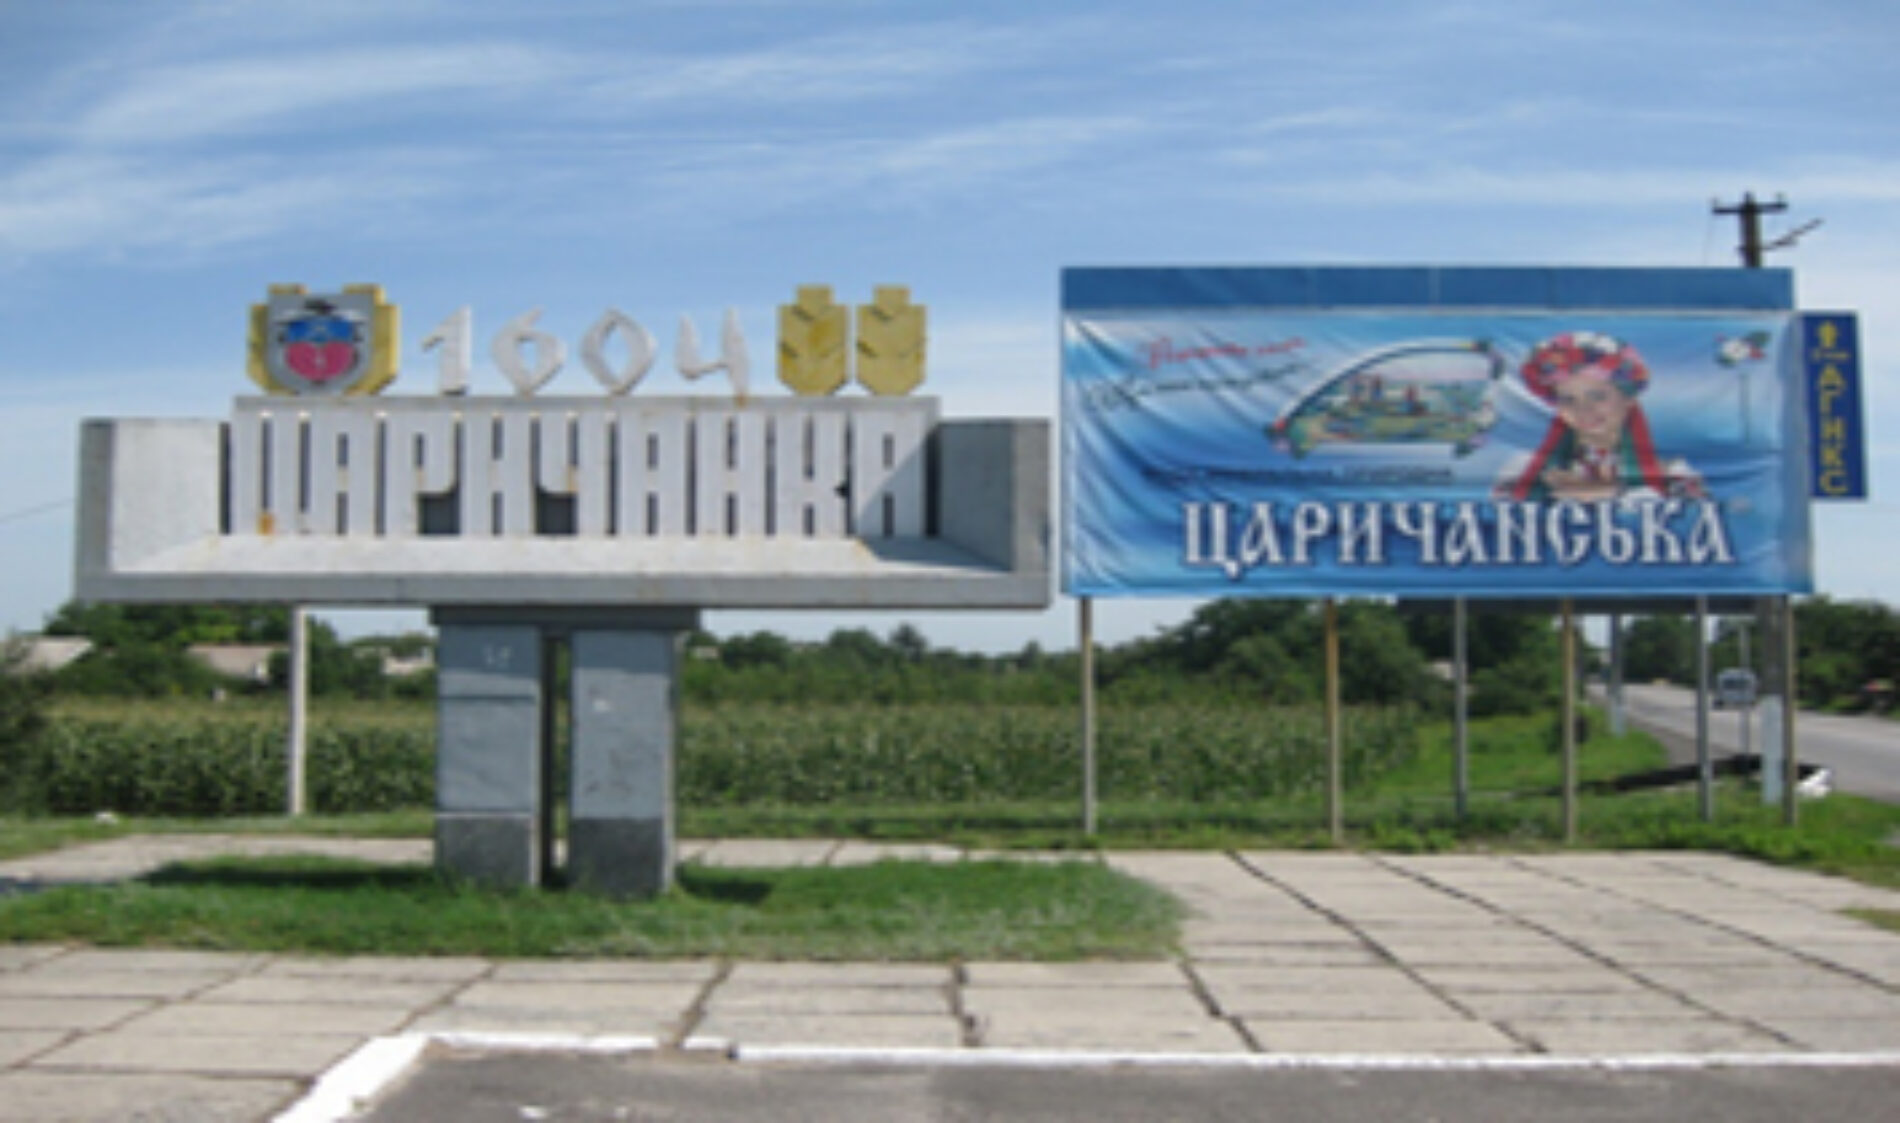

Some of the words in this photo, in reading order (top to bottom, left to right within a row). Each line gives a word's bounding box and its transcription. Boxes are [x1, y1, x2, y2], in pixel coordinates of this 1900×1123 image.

[420, 306, 751, 401] 1604
[230, 409, 932, 536] ЦАРИЧАНКА
[1184, 500, 1734, 578] ЦАРИЧАНСЬКА
